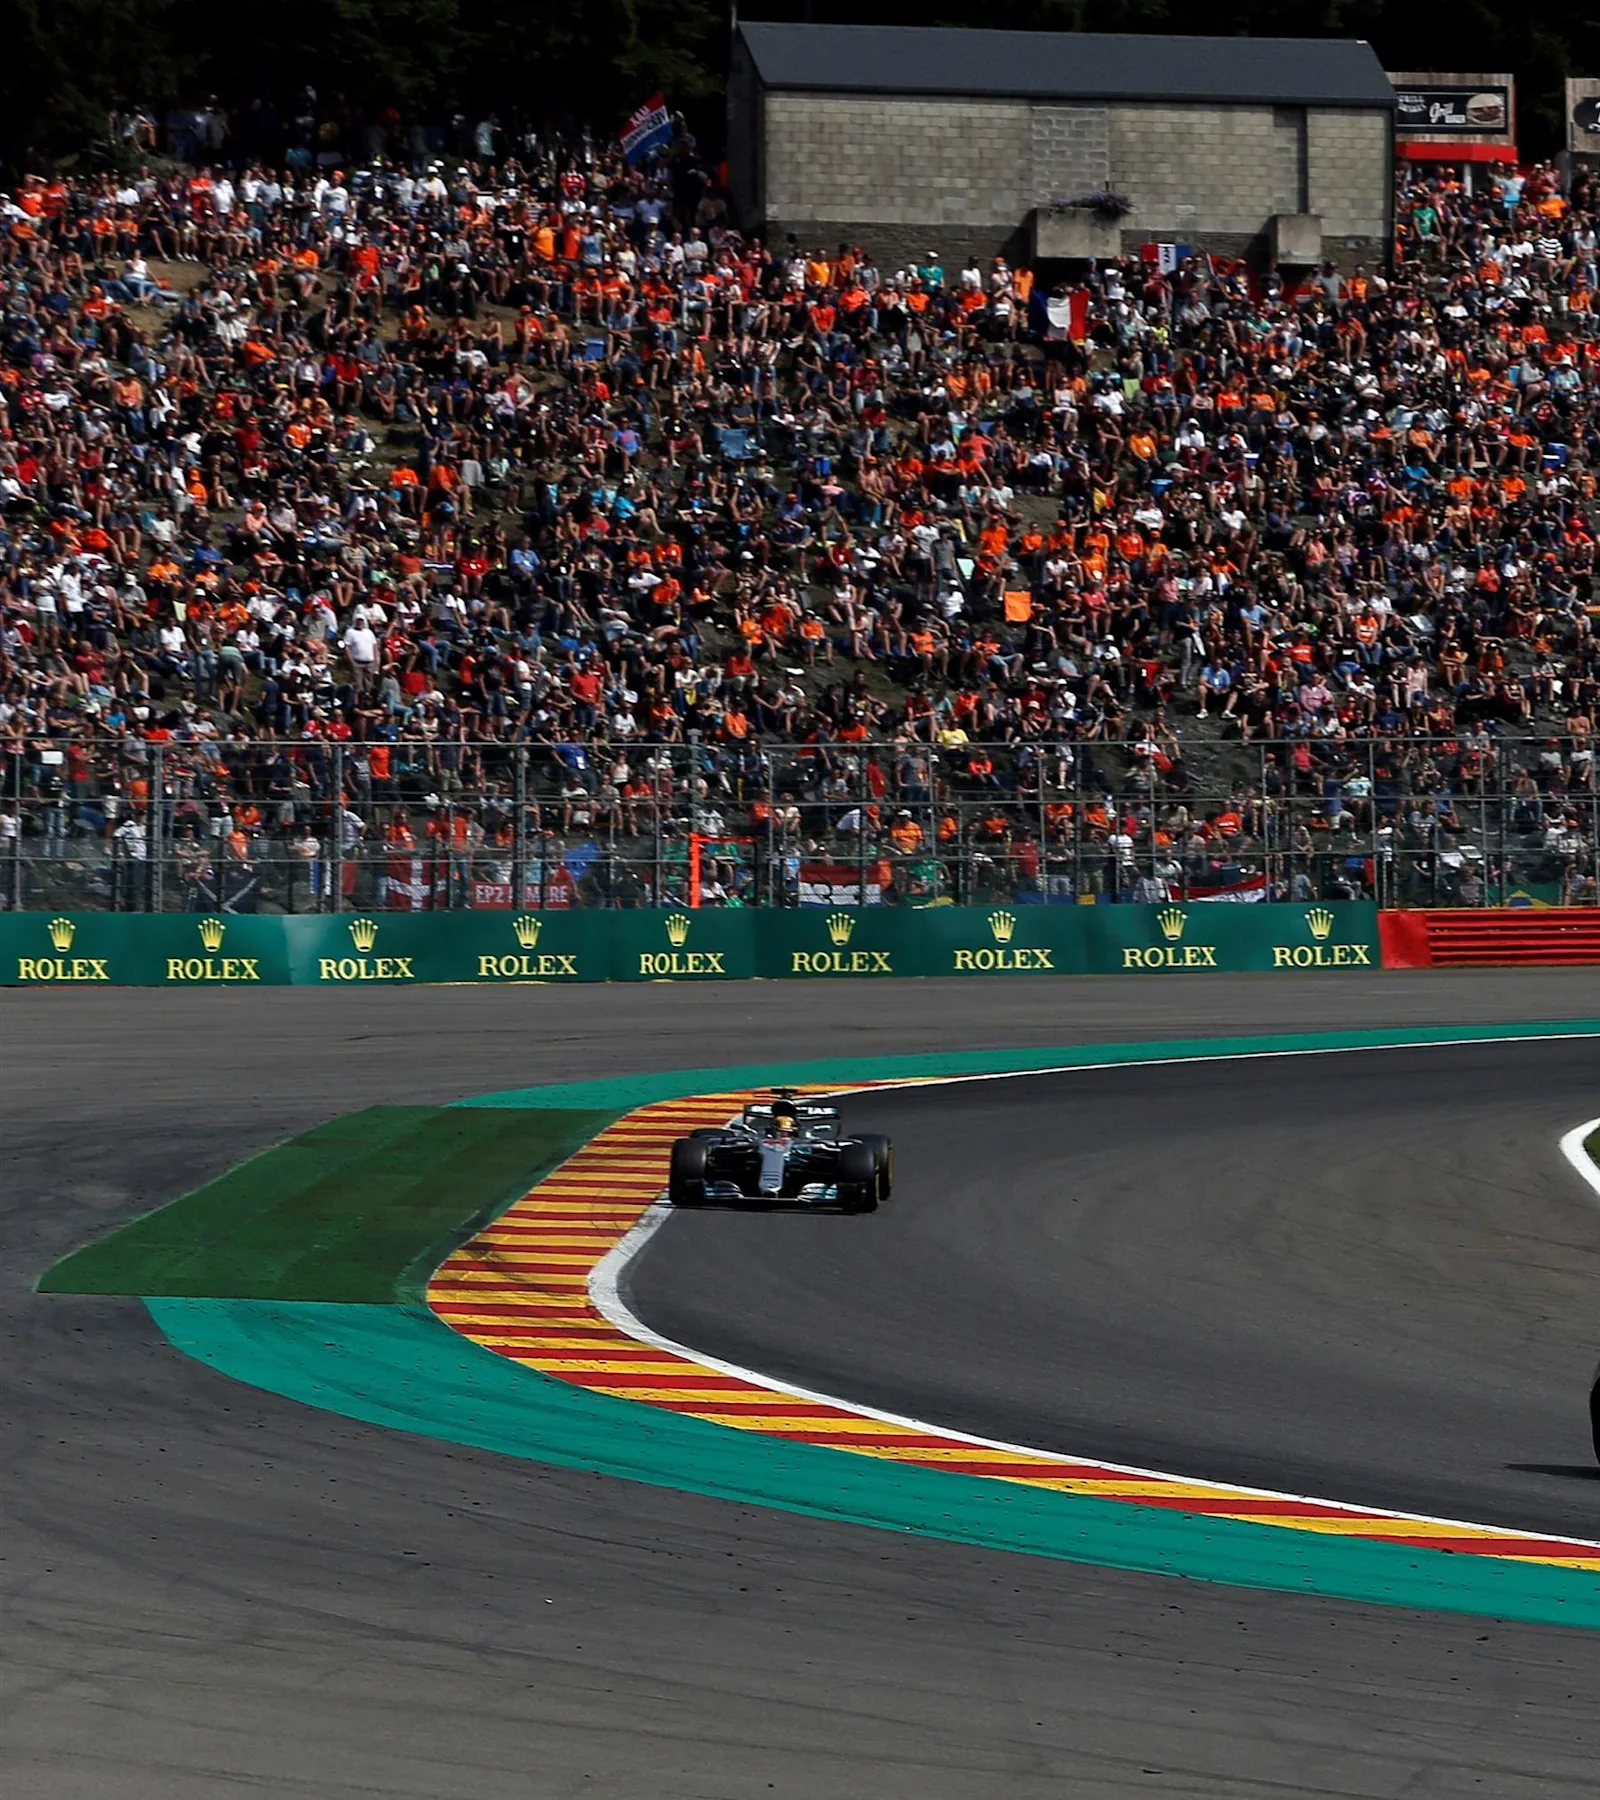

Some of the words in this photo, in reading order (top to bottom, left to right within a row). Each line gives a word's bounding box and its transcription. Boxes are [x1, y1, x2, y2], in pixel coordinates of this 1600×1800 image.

[478, 954, 577, 976] ROLEX
[639, 951, 724, 974] ROLEX
[791, 951, 891, 972] ROLEX
[954, 947, 1055, 969] ROLEX
[1123, 946, 1217, 967] ROLEX
[1273, 944, 1371, 966] ROLEX
[19, 958, 109, 979] ROLEX
[167, 958, 260, 980] ROLEX
[320, 957, 414, 979] ROLEX
